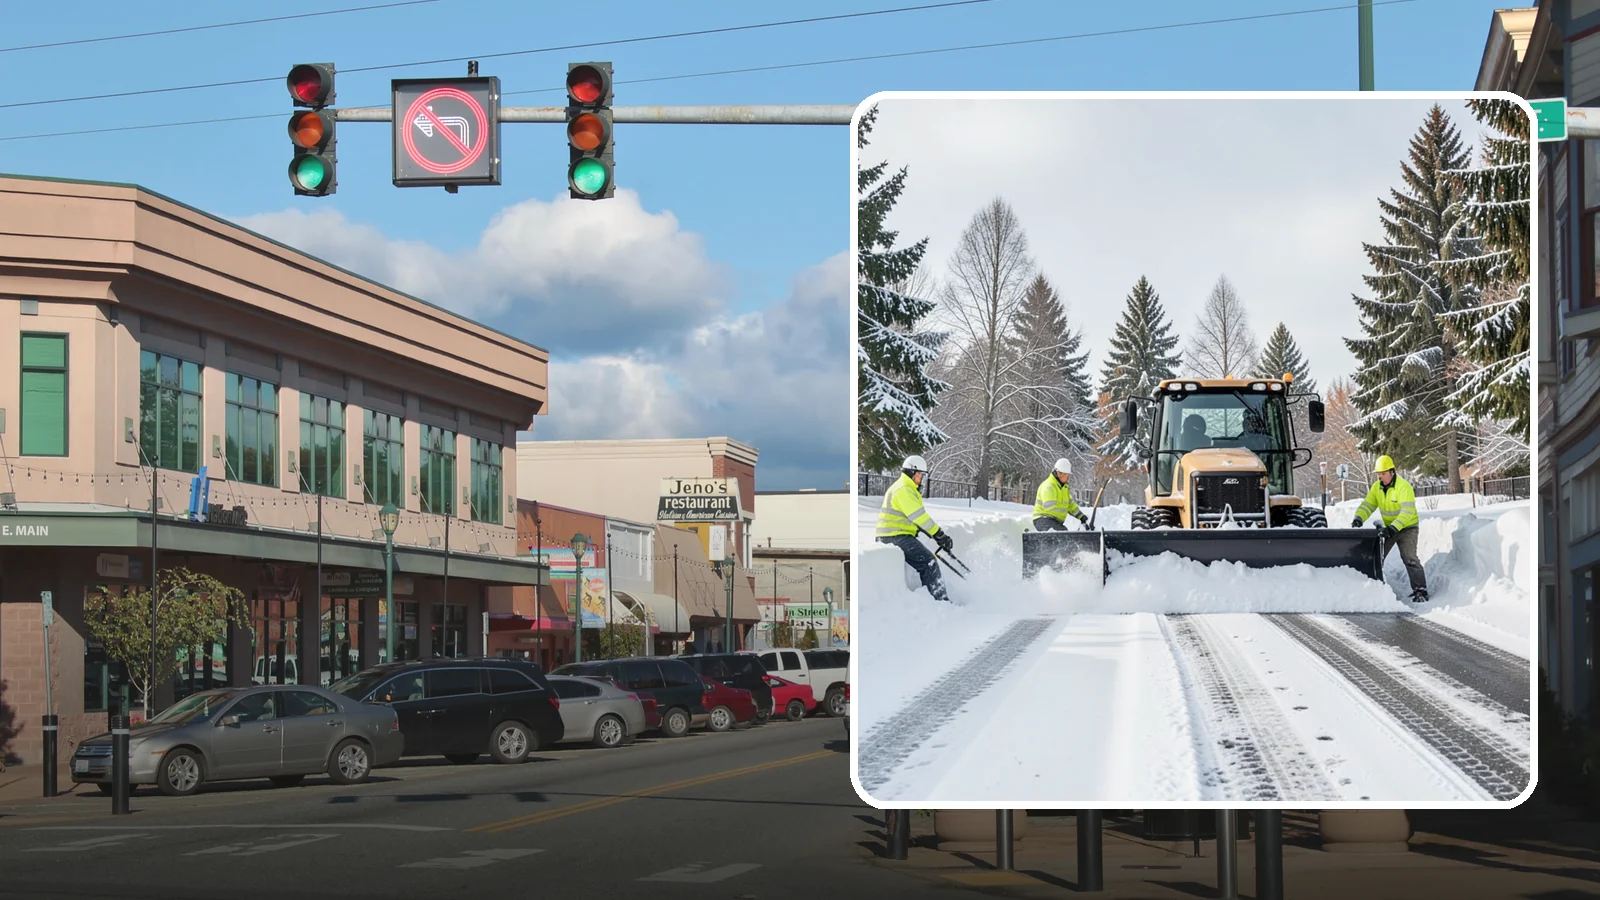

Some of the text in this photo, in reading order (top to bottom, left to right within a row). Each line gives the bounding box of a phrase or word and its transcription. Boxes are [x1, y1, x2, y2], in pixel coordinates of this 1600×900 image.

[670, 480, 727, 494] Jeno's
[665, 497, 731, 509] restaurant
[659, 510, 680, 519] Italian
[686, 510, 714, 519] American
[715, 509, 737, 519] Cuisine
[2, 525, 49, 536] E. MAIN
[797, 608, 828, 617] Street
